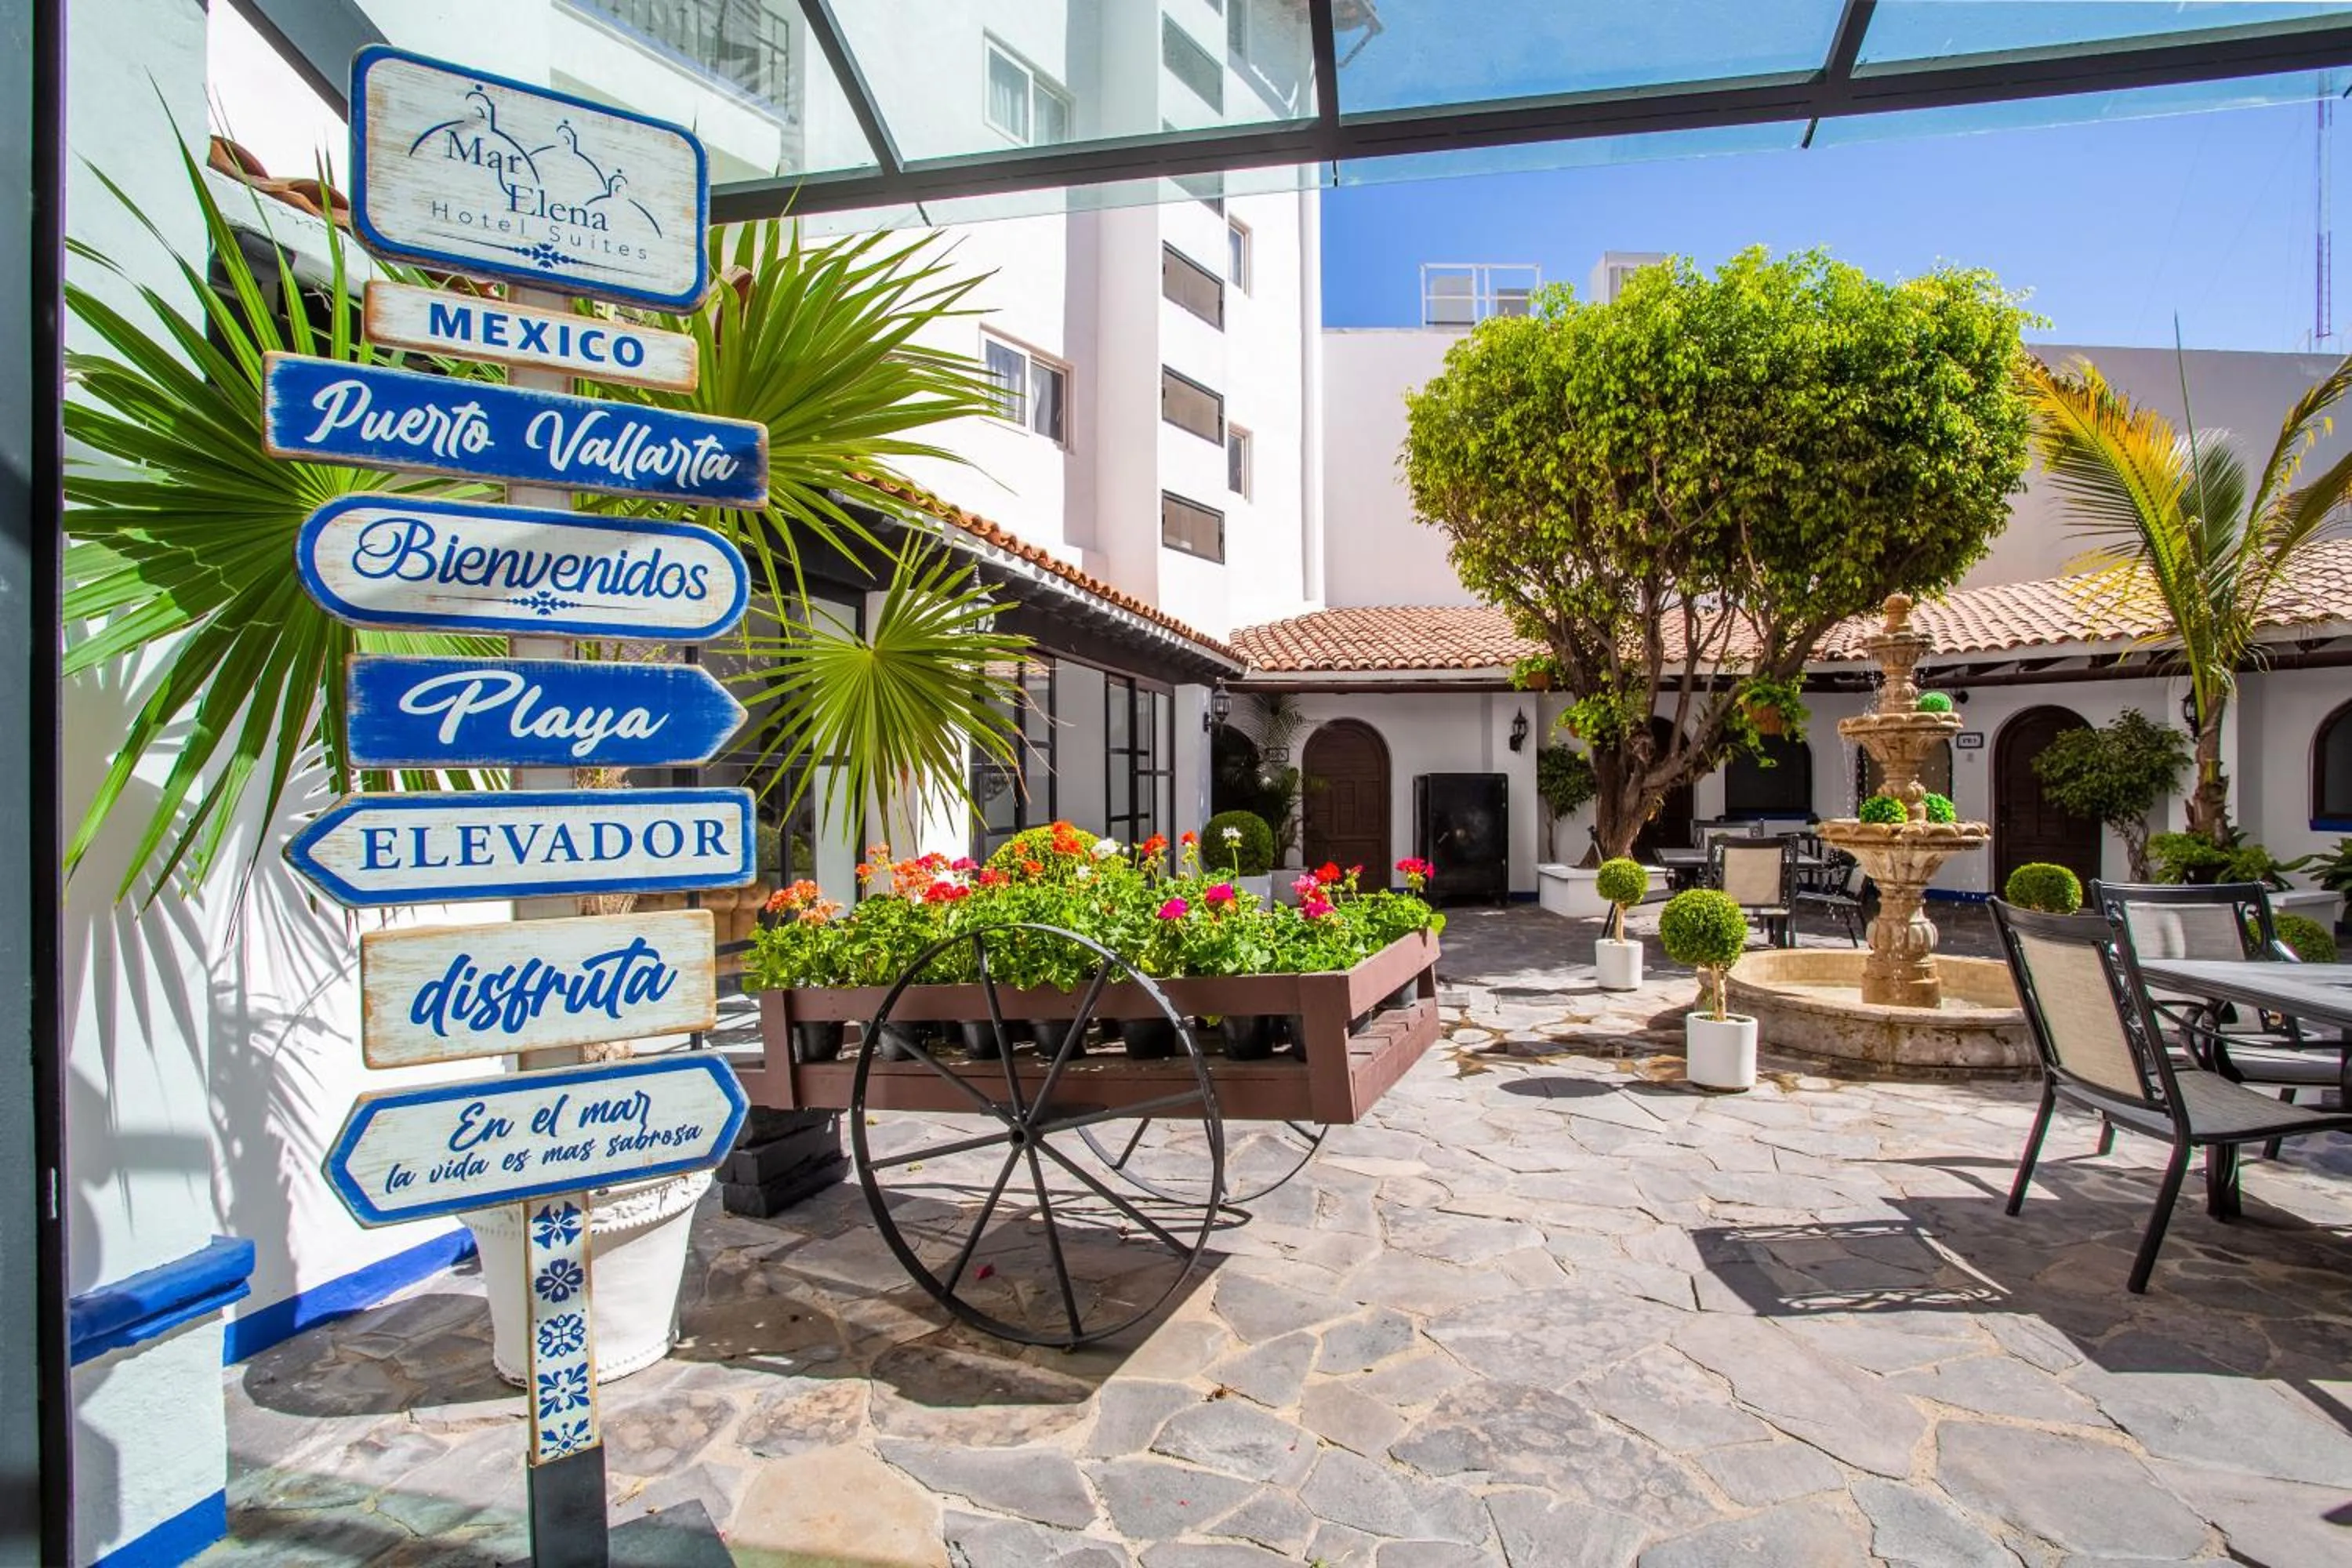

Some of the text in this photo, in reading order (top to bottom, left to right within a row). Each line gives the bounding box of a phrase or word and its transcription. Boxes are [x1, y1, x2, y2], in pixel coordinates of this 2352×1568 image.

[445, 129, 521, 174] Mar
[432, 200, 647, 260] Hotel Suites
[508, 183, 609, 231] Elena
[430, 303, 644, 368] MEXICO
[305, 380, 739, 488] Puerto Vallarta
[352, 517, 710, 601] Bienvenidos
[398, 670, 670, 757] Playa
[360, 819, 730, 870] ELEVADOR
[410, 937, 677, 1036] disfruta
[448, 1091, 651, 1153] En el mar
[384, 1123, 703, 1194] la vida es mas sabrosa
